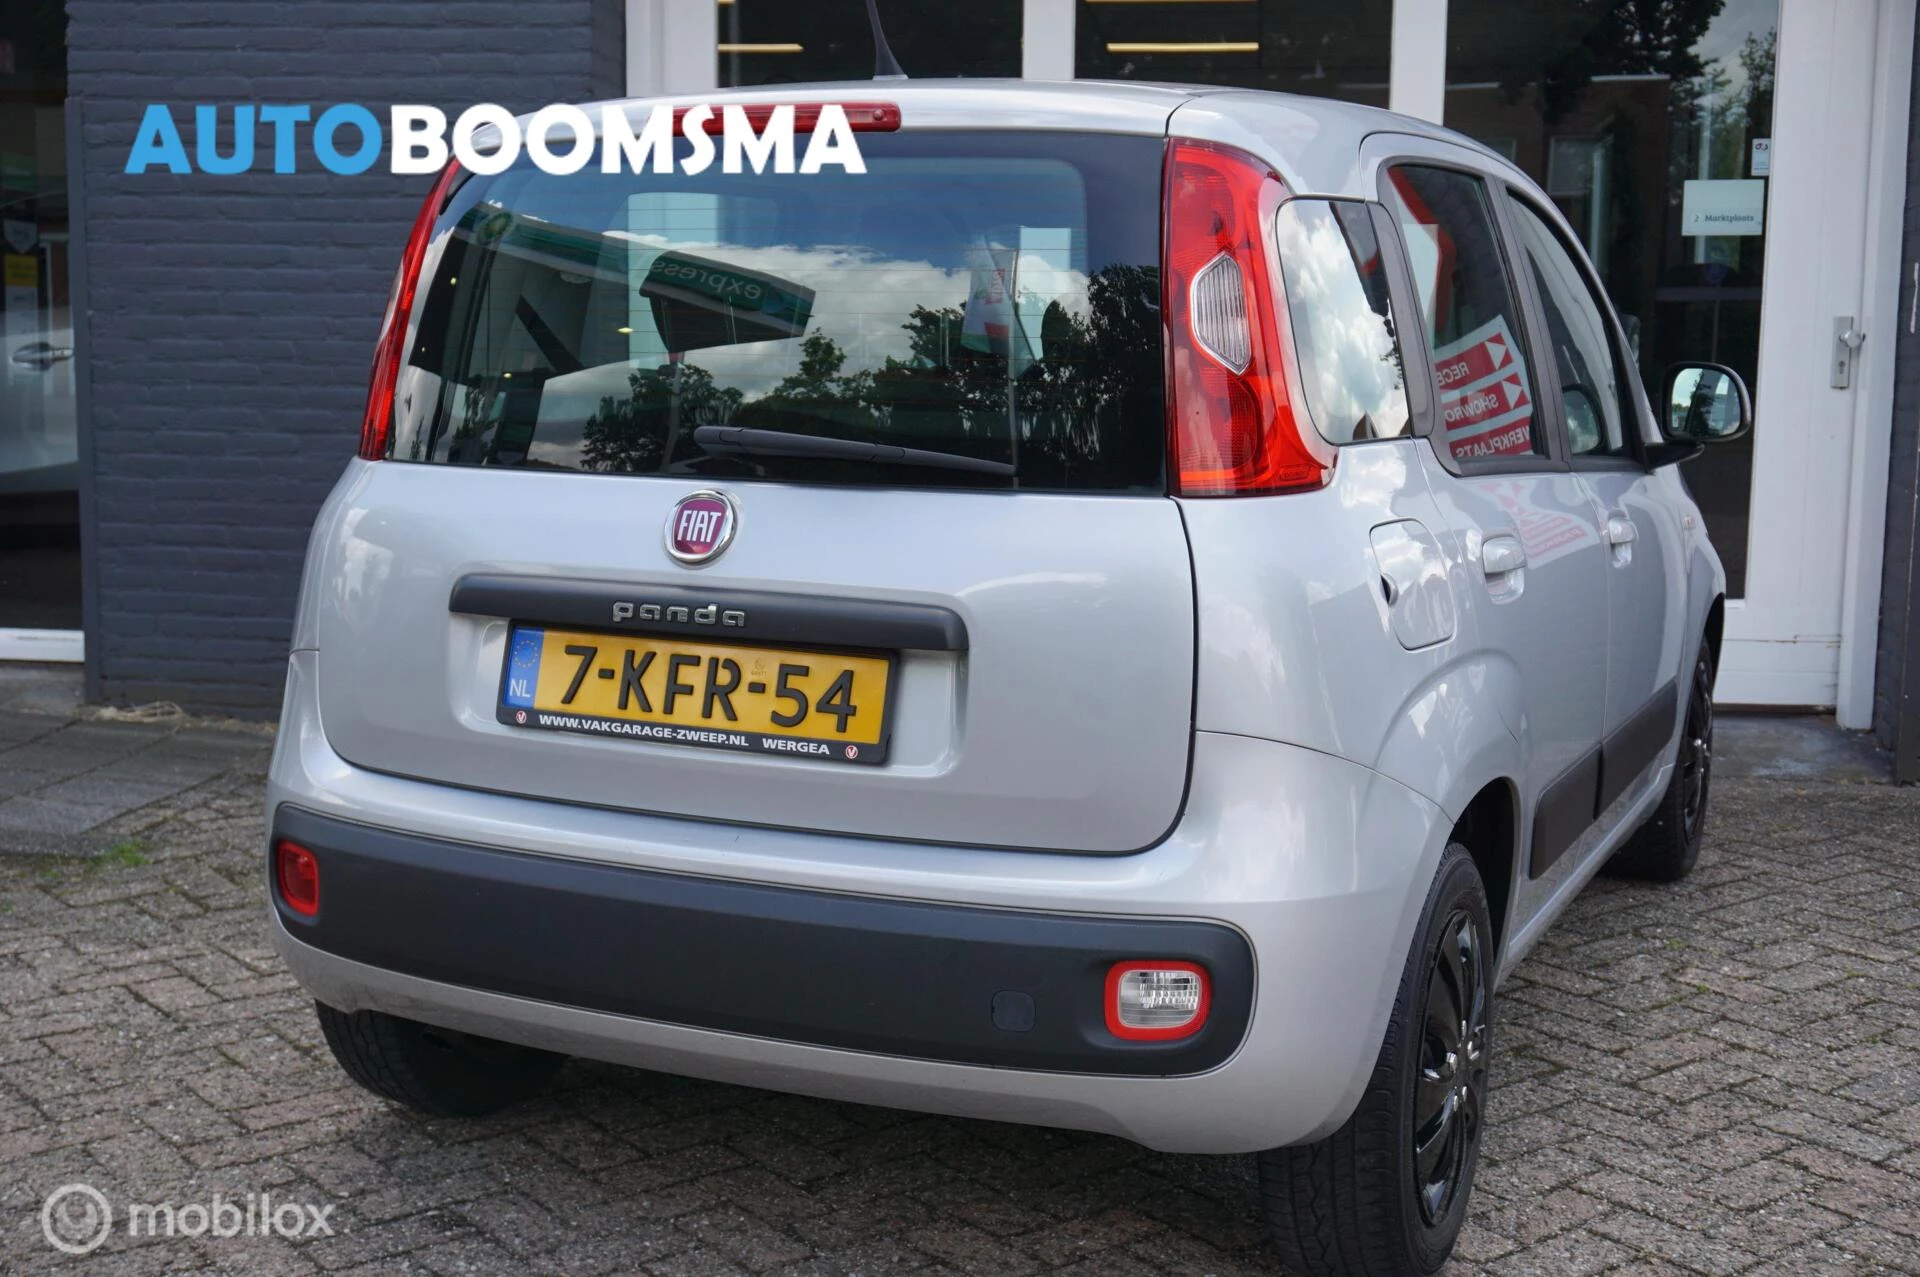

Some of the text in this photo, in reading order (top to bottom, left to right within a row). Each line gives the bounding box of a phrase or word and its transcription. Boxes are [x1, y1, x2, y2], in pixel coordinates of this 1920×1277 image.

[677, 509, 722, 543] FIAT
[509, 678, 531, 698] NL
[559, 643, 858, 734] 7-KFR-54
[538, 713, 831, 756] WWW.VAKGARAGE-ZWEEP.NL WERGEA
